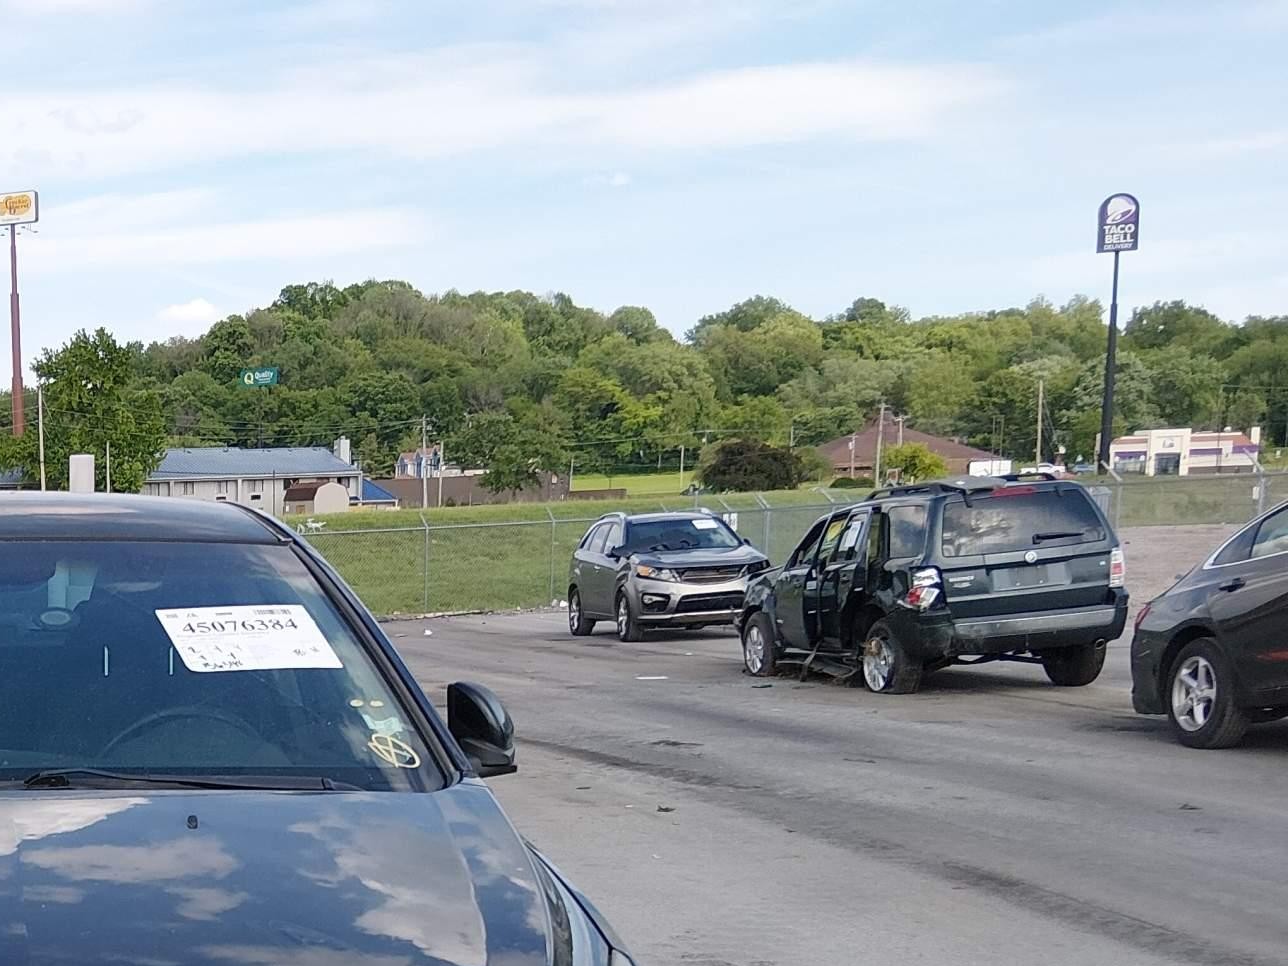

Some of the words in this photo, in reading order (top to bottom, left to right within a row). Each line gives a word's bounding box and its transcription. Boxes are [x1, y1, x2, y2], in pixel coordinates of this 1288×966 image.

[1103, 223, 1135, 234] TACO
[1104, 233, 1135, 243] BELL
[254, 370, 274, 380] Quality
[182, 617, 298, 634] 45076384
